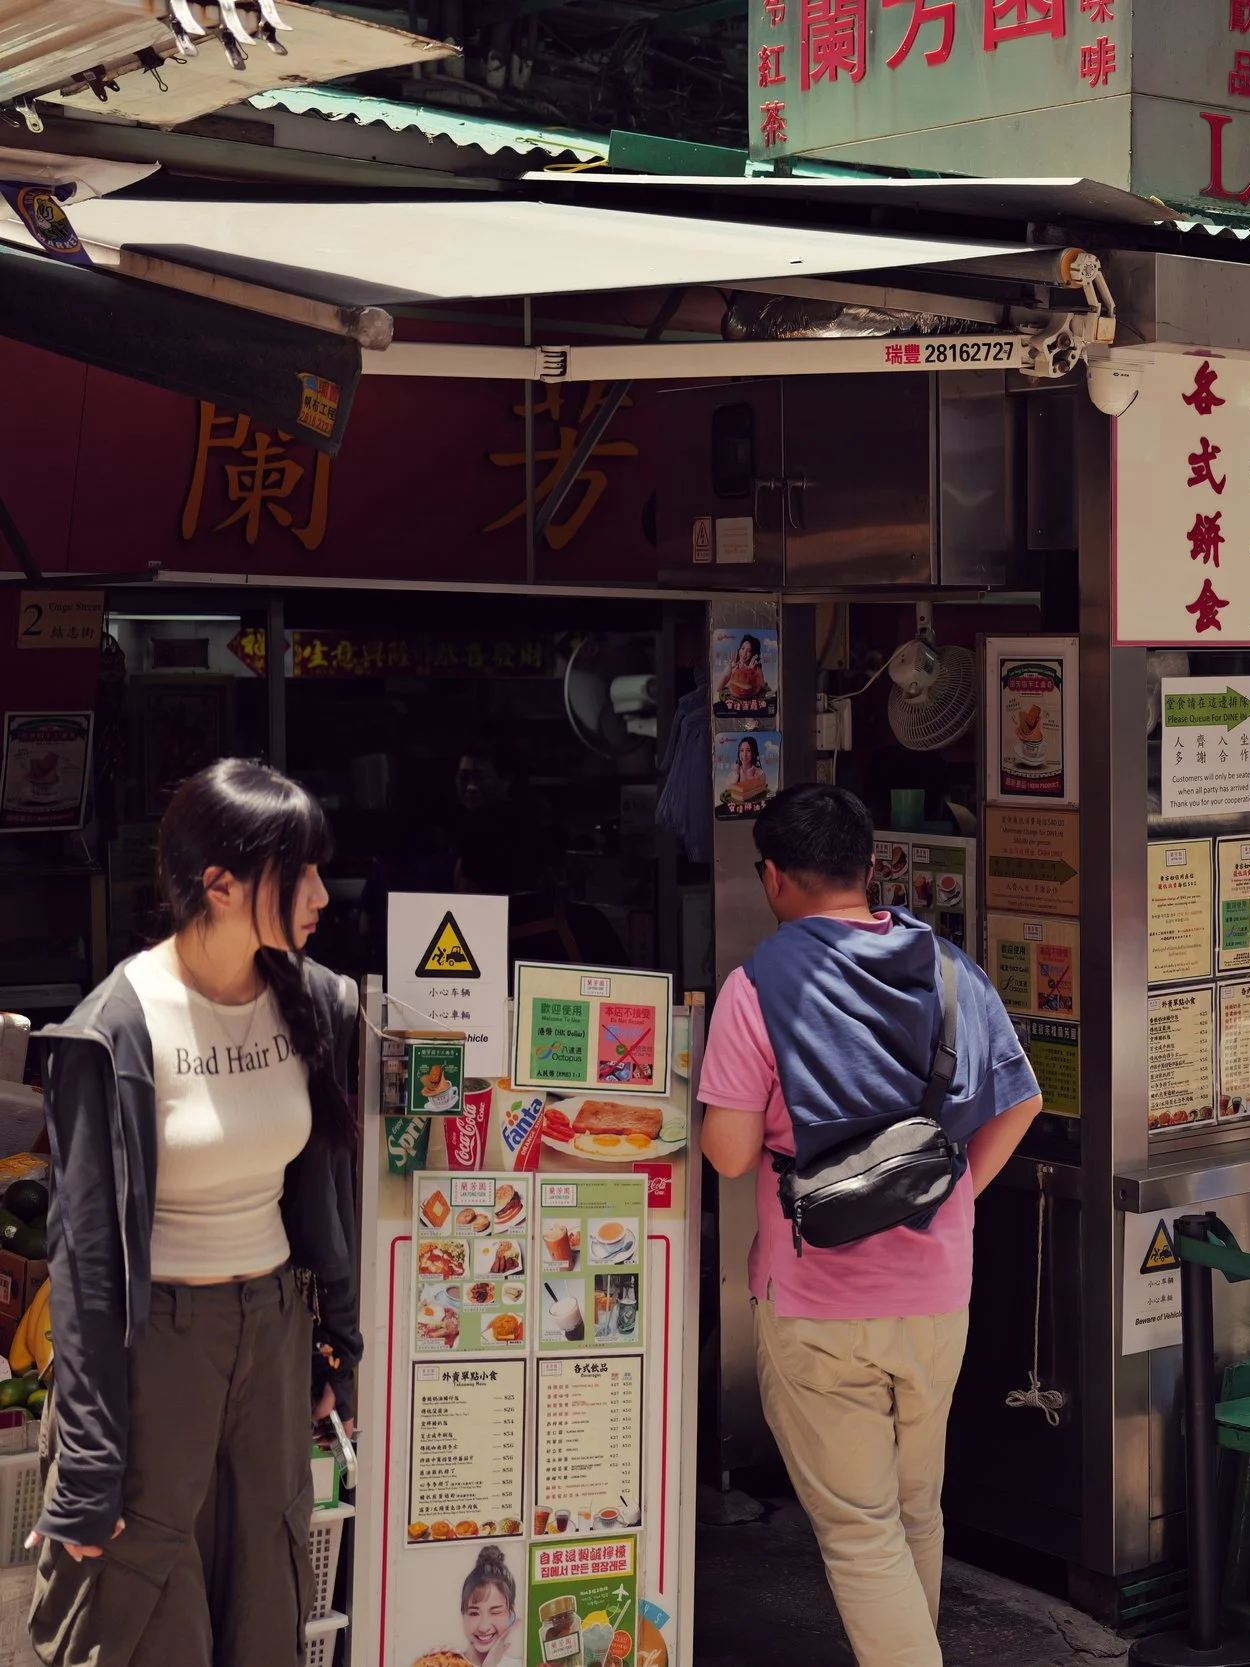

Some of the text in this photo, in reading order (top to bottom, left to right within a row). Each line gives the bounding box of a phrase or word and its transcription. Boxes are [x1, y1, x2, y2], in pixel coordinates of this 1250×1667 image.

[884, 341, 1014, 366] 瑞豐 28162727
[1181, 359, 1230, 633] 各式餅食
[22, 604, 44, 635] 2
[1167, 714, 1188, 723] Please
[1189, 714, 1210, 723] Queue
[1211, 713, 1222, 721] For
[1223, 712, 1239, 721] DINE
[1174, 748, 1249, 766] 多謝合作
[1172, 775, 1203, 783] Customers
[1204, 773, 1214, 781] will
[1215, 772, 1227, 782] only
[1228, 771, 1236, 780] be
[1178, 784, 1249, 796] when all party has arrived
[1170, 799, 1189, 808] Thank
[1189, 799, 1200, 809] you
[1201, 798, 1210, 806] for
[1210, 798, 1223, 807] your
[175, 1046, 219, 1076] Bad
[226, 1042, 270, 1075] Hair
[551, 1052, 582, 1062] Octopus
[502, 1097, 543, 1153] Fanta
[1135, 1316, 1156, 1326] Beware
[1156, 1313, 1163, 1322] of
[574, 1363, 609, 1374] 各式飲品
[442, 1370, 498, 1382] 外賣單點小食
[540, 1559, 628, 1579] 집에서 만든 염장레몬
